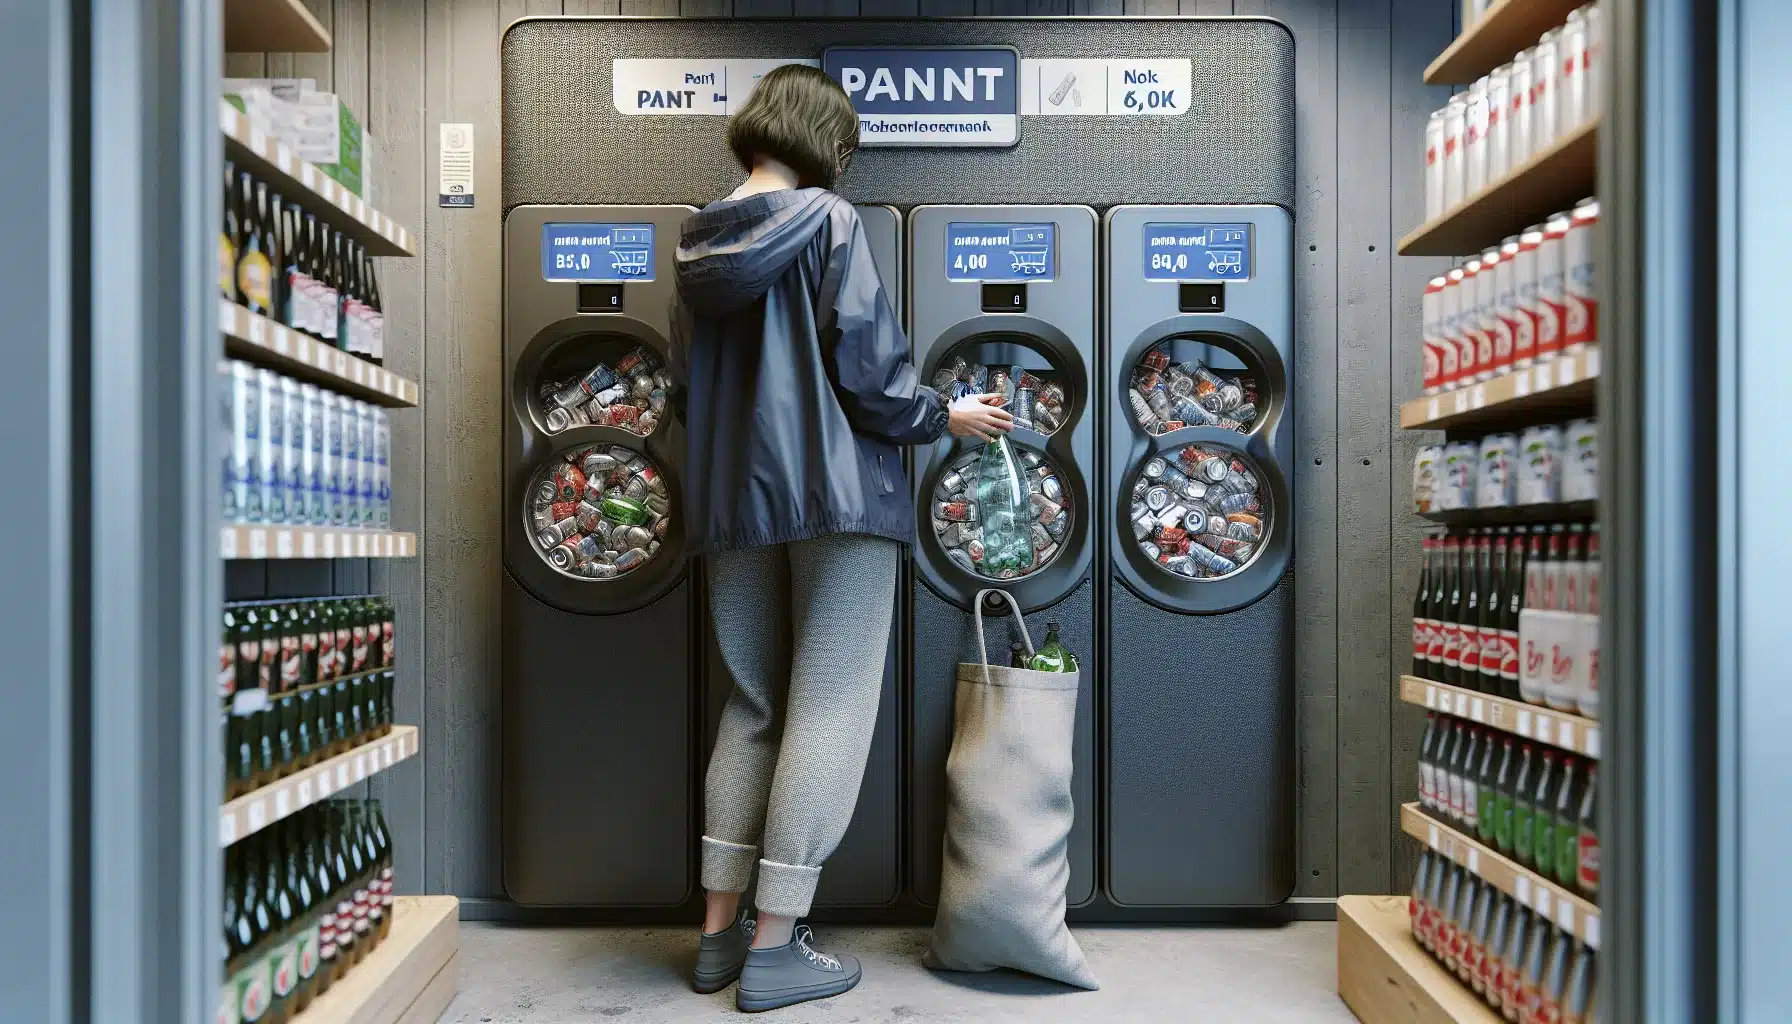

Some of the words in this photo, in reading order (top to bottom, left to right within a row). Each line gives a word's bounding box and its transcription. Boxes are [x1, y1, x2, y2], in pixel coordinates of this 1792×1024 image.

[841, 67, 1004, 102] PANNT
[1124, 69, 1159, 84] Nok
[637, 90, 696, 108] PANT
